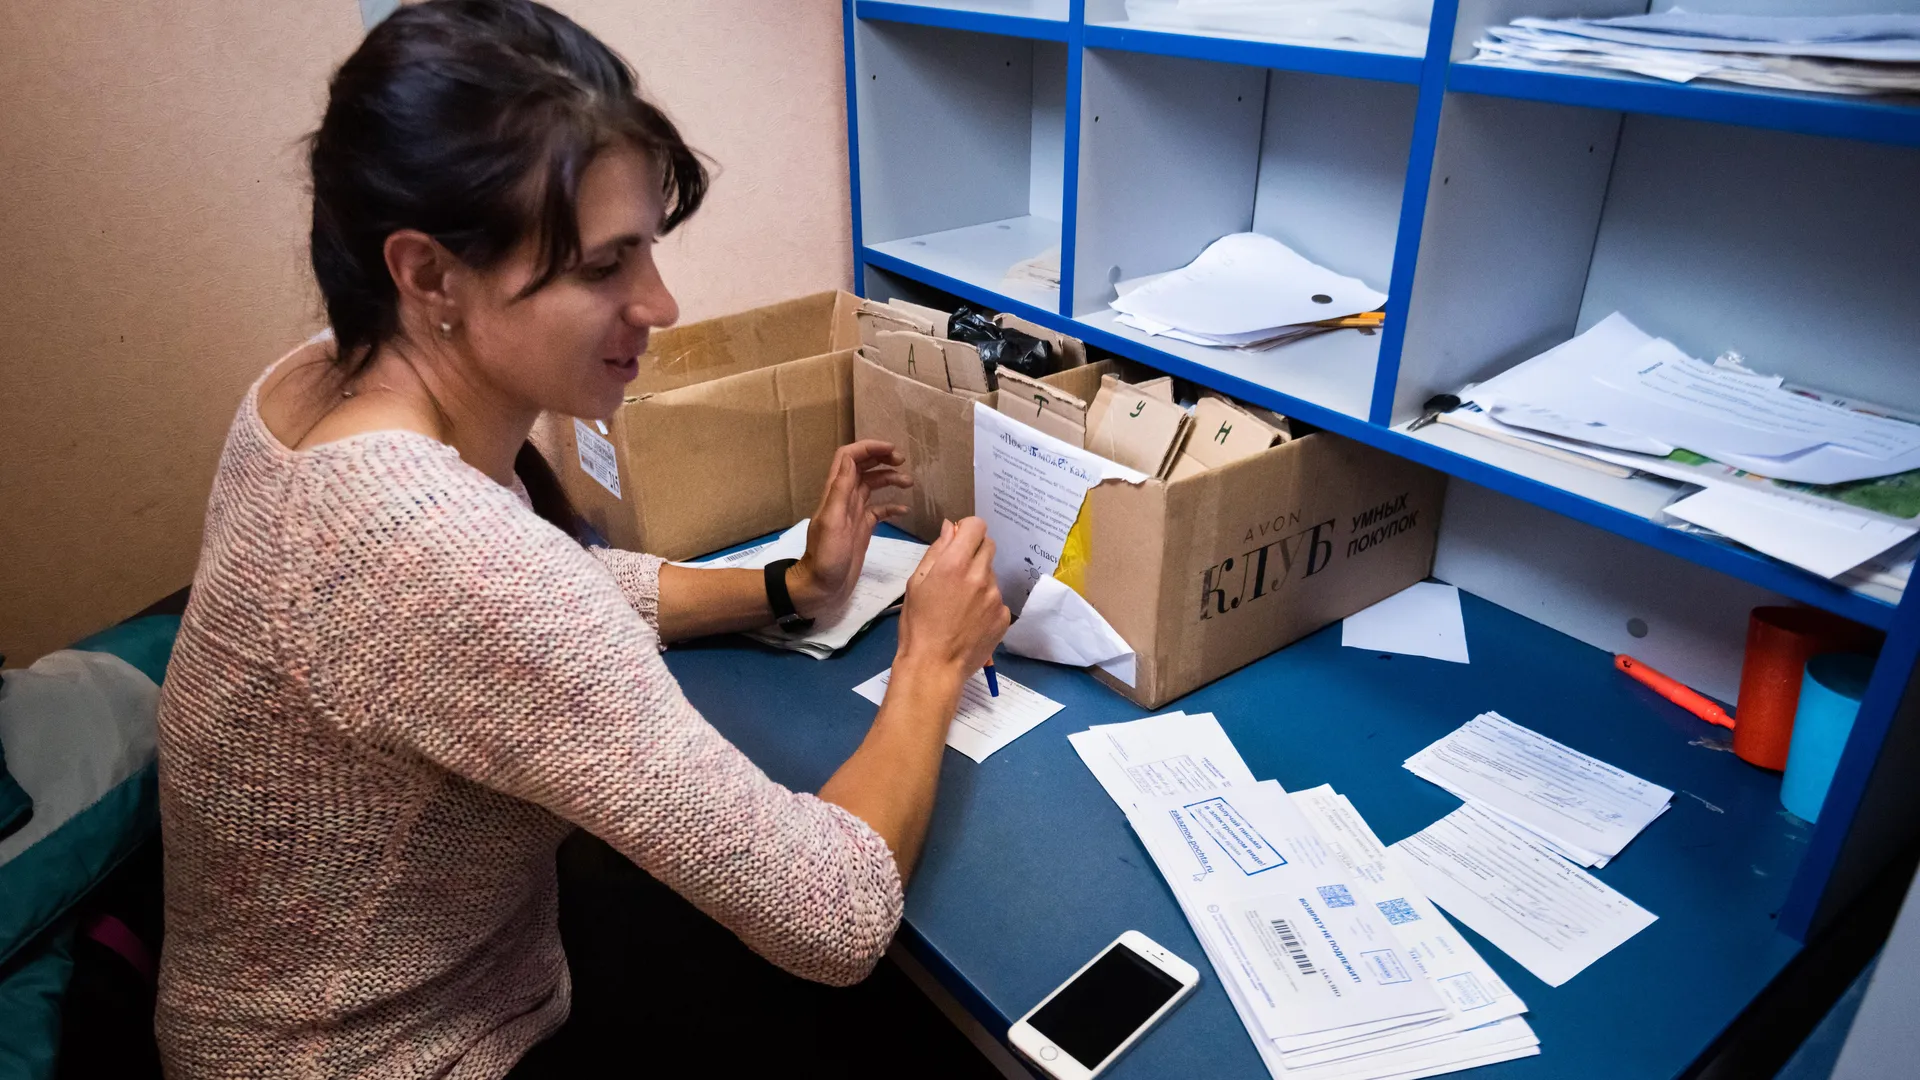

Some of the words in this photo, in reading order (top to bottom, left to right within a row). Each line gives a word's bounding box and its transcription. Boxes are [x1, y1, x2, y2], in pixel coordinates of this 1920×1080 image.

[1243, 509, 1301, 543] AVON
[1346, 510, 1420, 558] ПОКУПОК
[1350, 492, 1409, 534] УМНЫХ
[1199, 518, 1336, 621] КЛУБ
